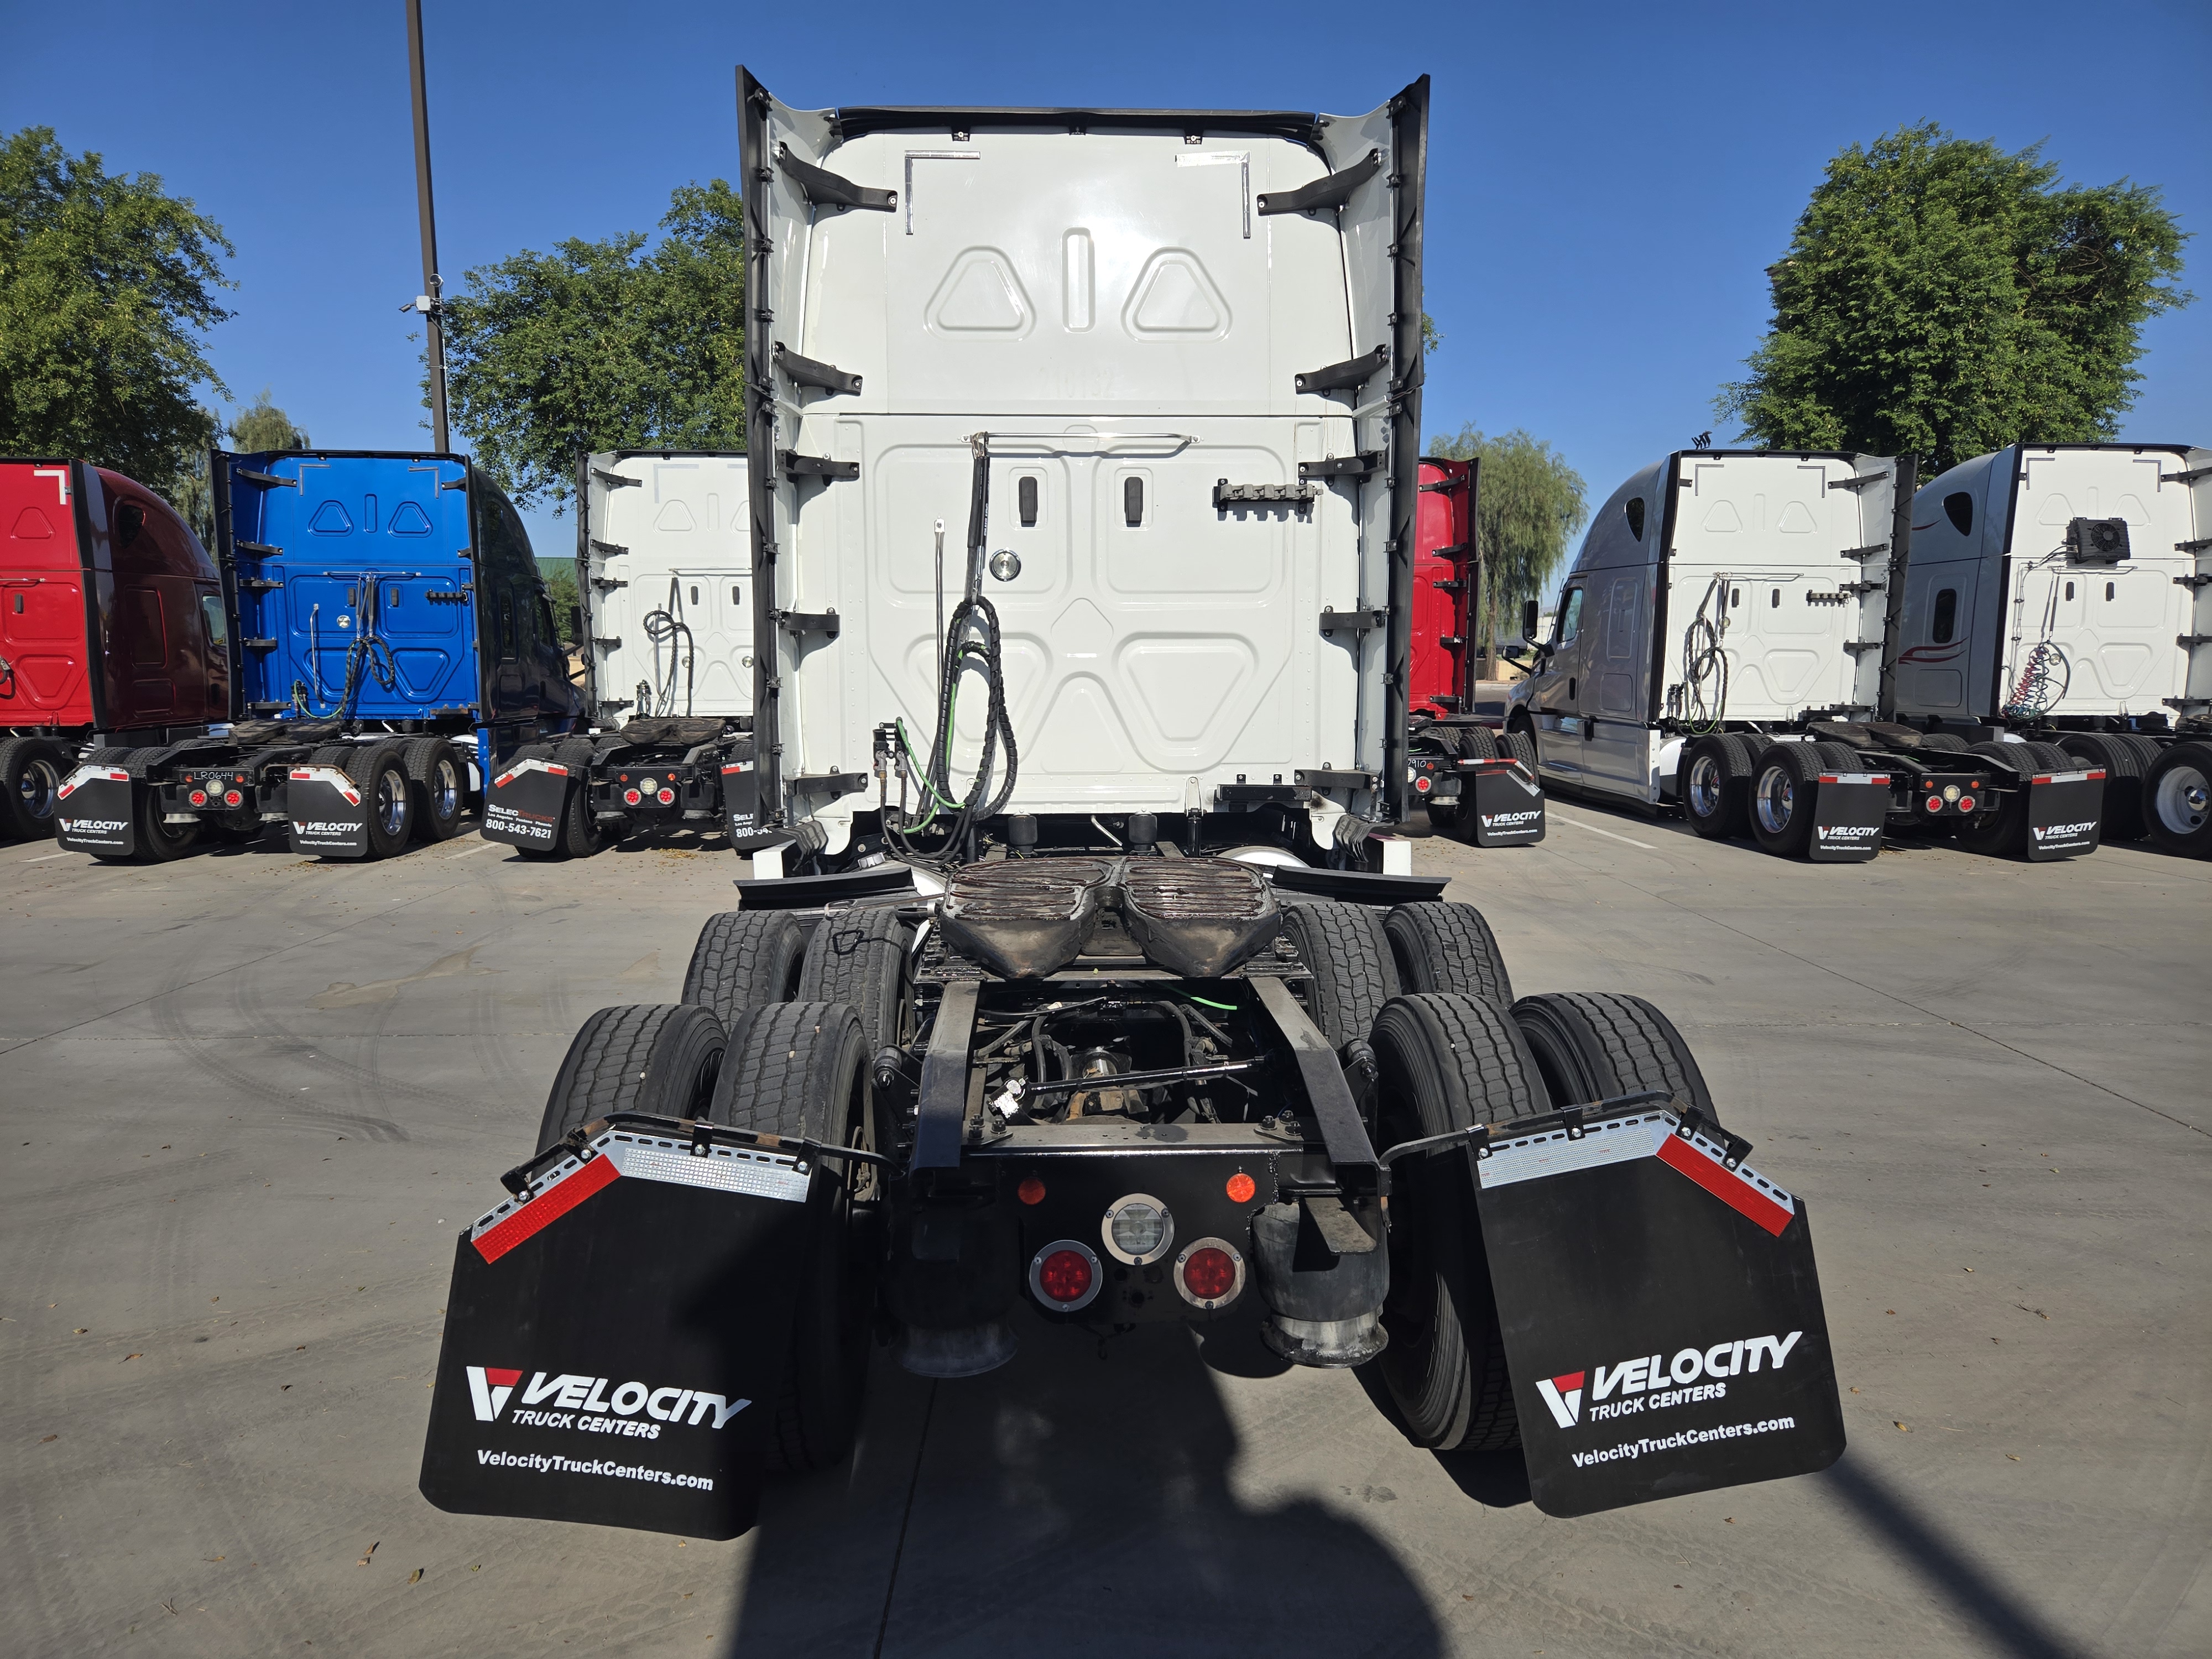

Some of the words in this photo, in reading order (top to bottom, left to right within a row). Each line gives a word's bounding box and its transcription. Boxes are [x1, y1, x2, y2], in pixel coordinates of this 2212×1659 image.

[72, 819, 129, 830] VELOCITY
[307, 822, 363, 832] VELOCITY
[486, 819, 552, 838] 800-543-7621
[1494, 811, 1541, 822] VELOCITY
[2046, 821, 2097, 834] VELOCITY
[1829, 826, 1879, 836] VELOCITY
[1593, 1331, 1802, 1401] VELOCITY
[521, 1371, 752, 1430] VELOCITY
[1589, 1399, 1644, 1422] TRUCK
[1648, 1383, 1726, 1410] CENTERS
[512, 1410, 575, 1430] TRUCK
[577, 1417, 661, 1439] CENTERS
[1572, 1416, 1794, 1468] VelocityTruckCenters.com
[477, 1450, 713, 1491] VelocityTruckCenters.com
